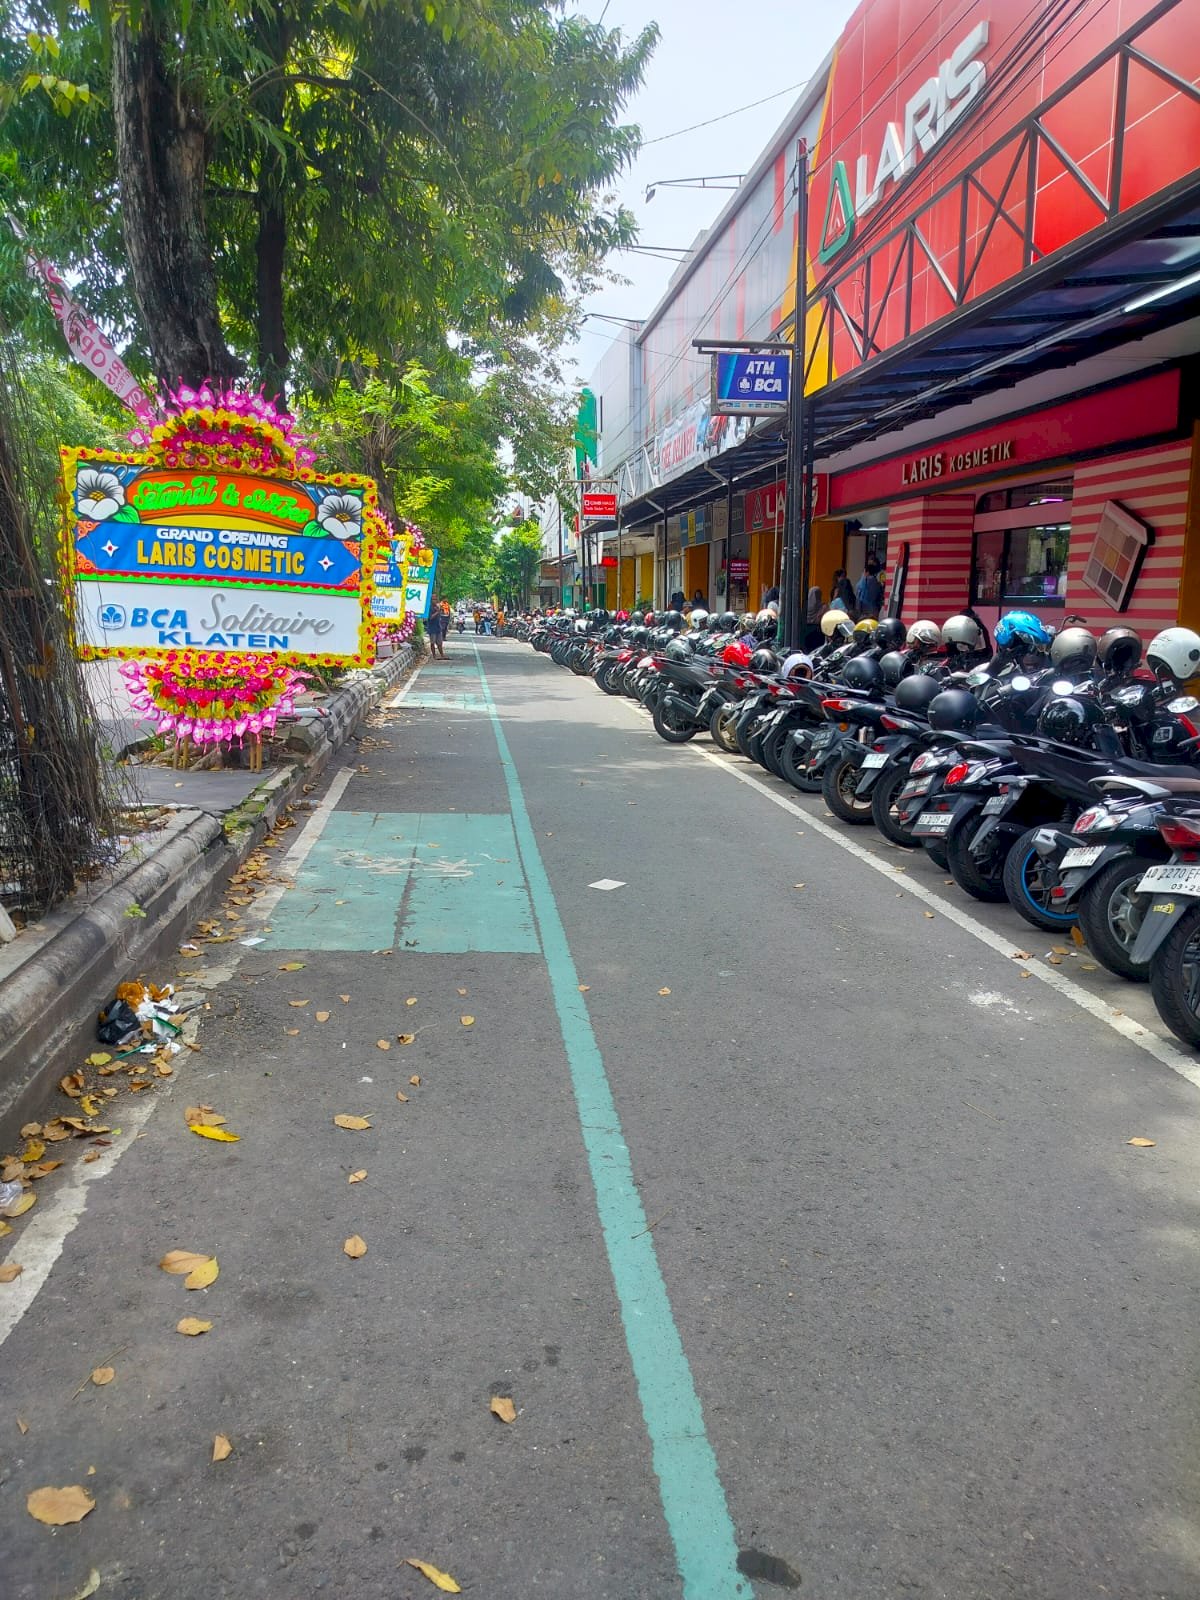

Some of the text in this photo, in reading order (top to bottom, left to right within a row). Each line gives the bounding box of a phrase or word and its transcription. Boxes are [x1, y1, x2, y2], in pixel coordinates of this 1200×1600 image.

[856, 20, 990, 218] LARIS
[745, 360, 776, 375] ATM
[754, 378, 782, 393] BCA
[901, 440, 1011, 485] LARIS KOSMETIK
[221, 483, 241, 507] &
[156, 528, 288, 549] GRAND OPENING
[137, 540, 305, 575] LARIS COSMETIC
[130, 593, 335, 636] BCA Solitaire
[158, 630, 289, 649] KLATEN
